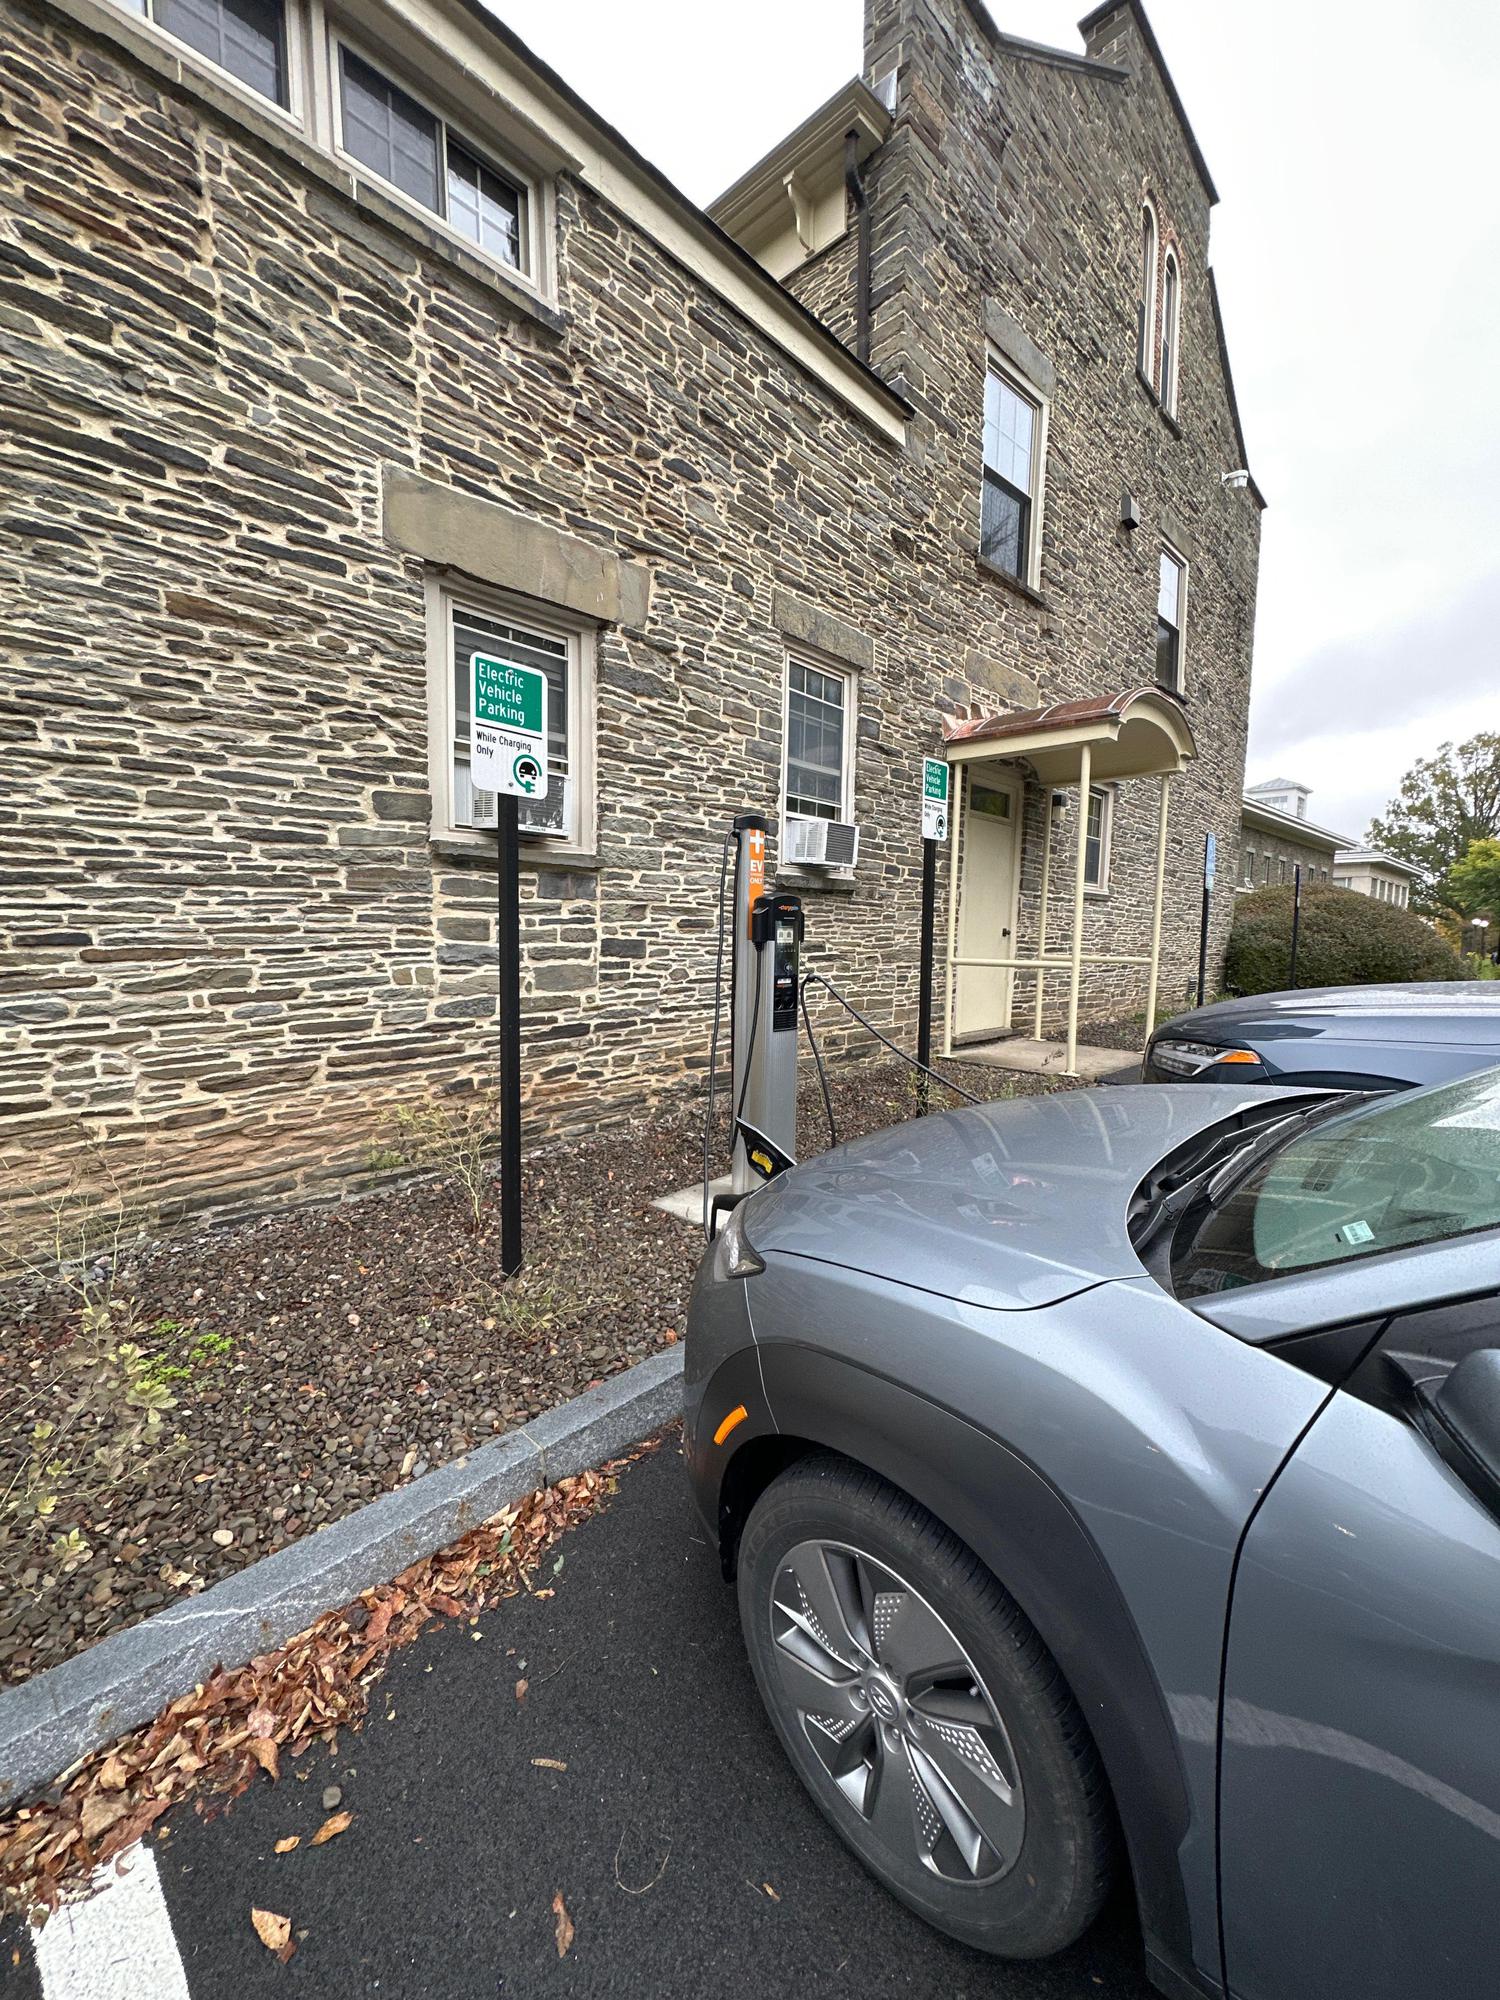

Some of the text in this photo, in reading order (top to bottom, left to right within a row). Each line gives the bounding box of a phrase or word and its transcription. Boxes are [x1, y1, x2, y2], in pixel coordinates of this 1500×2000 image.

[478, 662, 524, 689] Electric
[478, 679, 522, 705] Vehicle
[478, 697, 525, 726] Parking
[476, 730, 532, 754] While Charging
[476, 743, 494, 759] Only
[926, 763, 942, 776] Electric
[926, 774, 941, 786] Vehicle
[926, 783, 941, 798] Parking
[750, 860, 763, 872] EV
